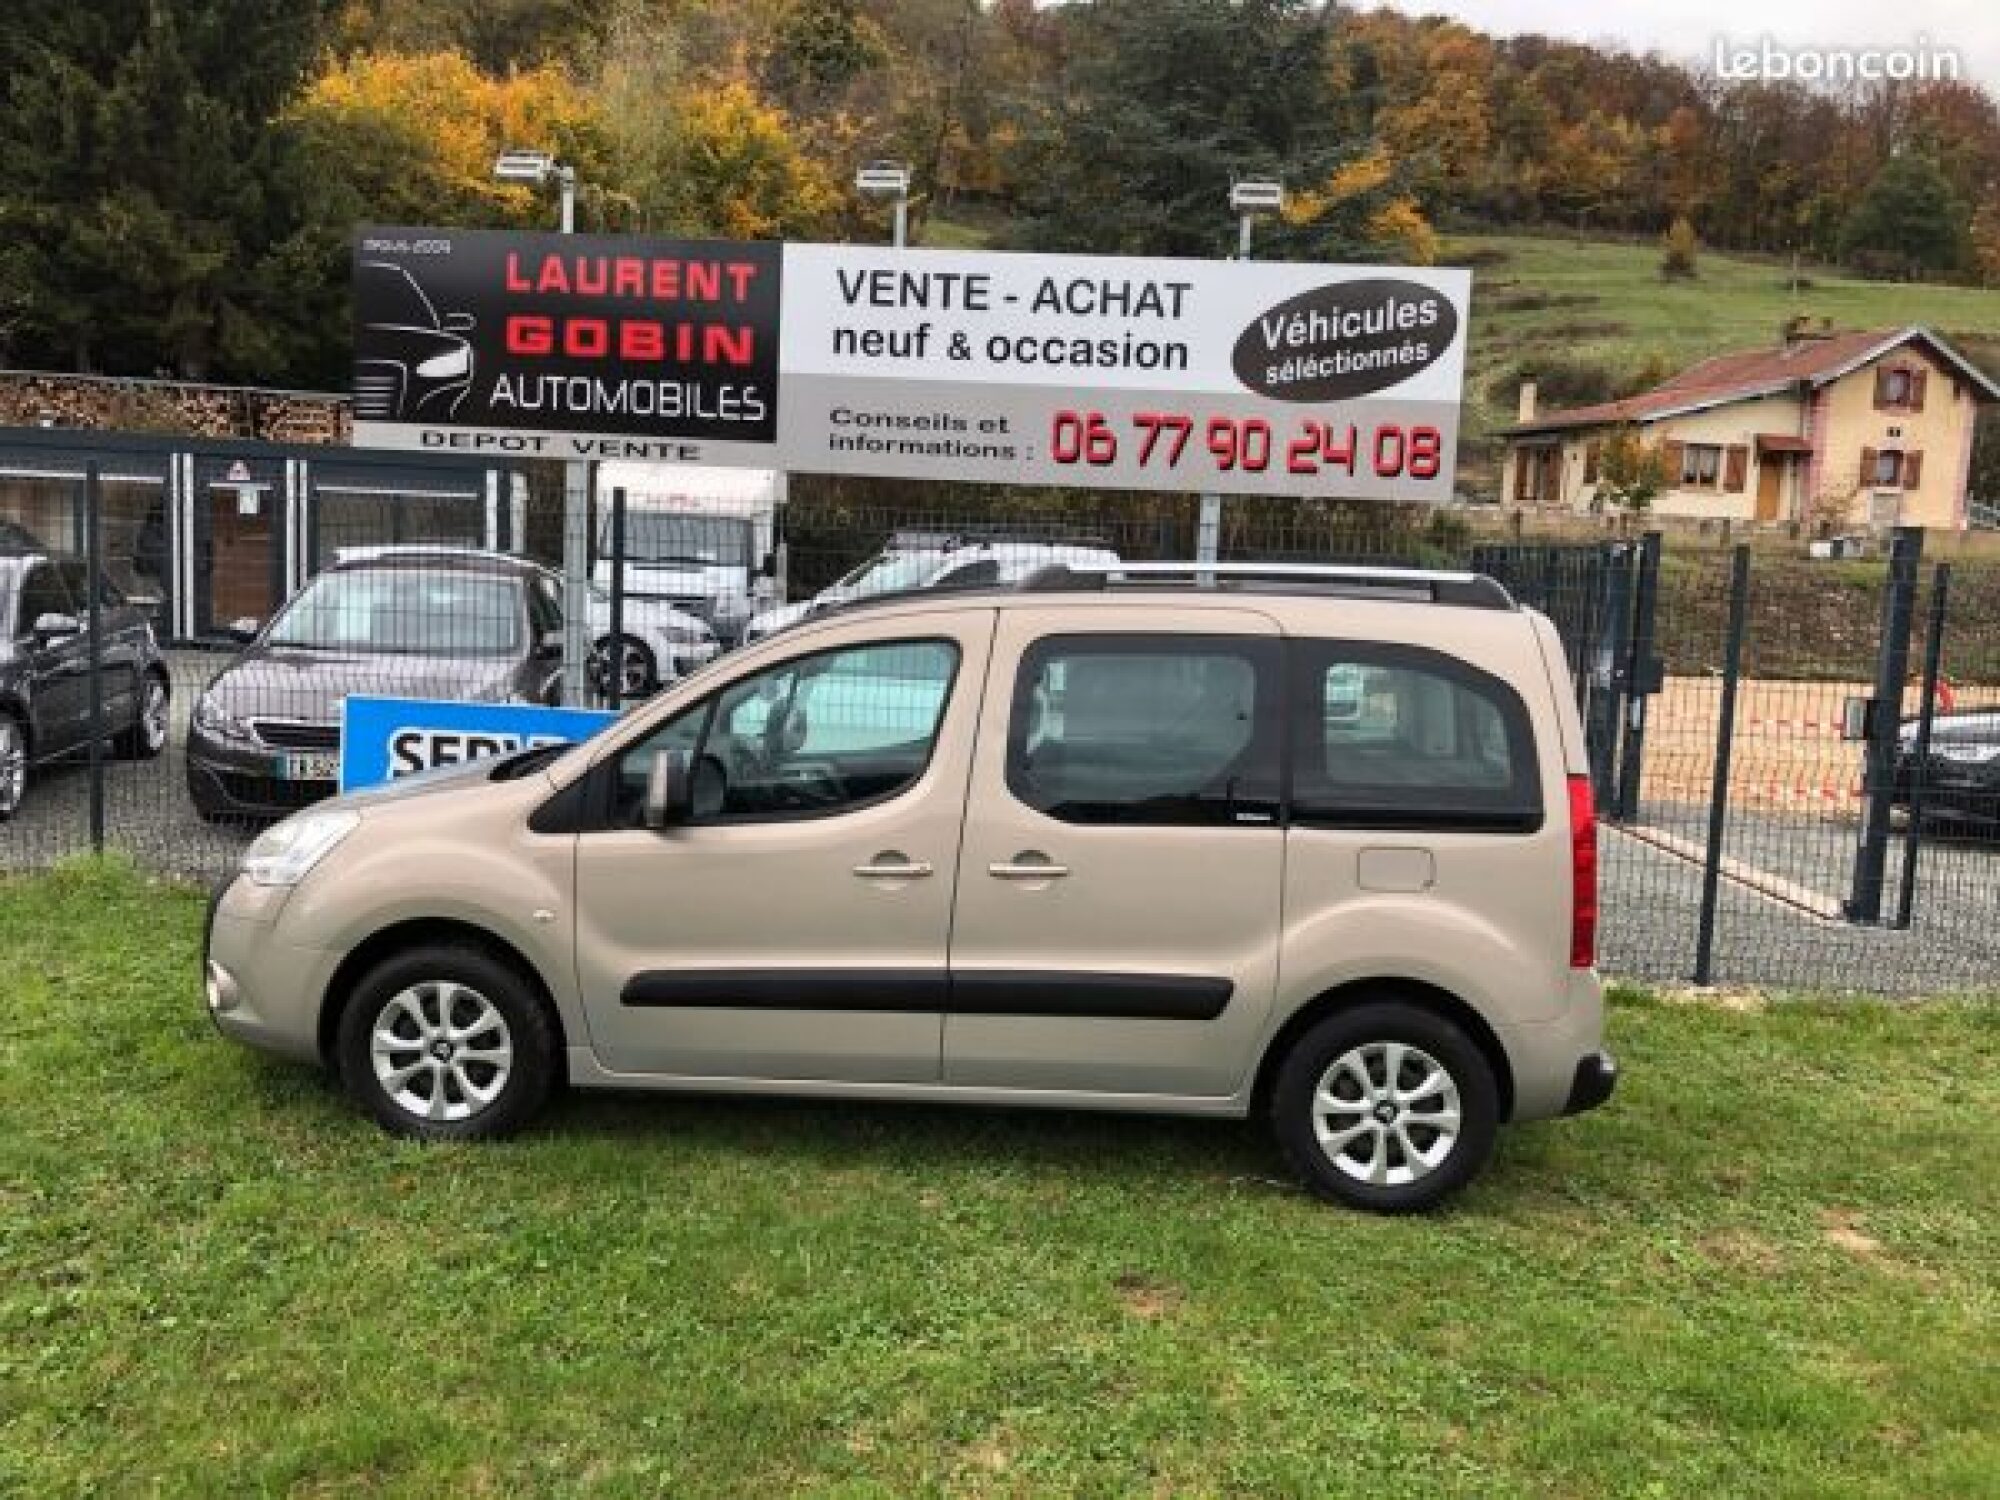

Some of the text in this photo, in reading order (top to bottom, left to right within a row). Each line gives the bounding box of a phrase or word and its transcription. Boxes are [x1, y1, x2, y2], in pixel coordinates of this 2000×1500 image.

[505, 251, 757, 302] LAURENT
[837, 268, 990, 310] VENTE
[1030, 276, 1192, 318] ACHAT
[505, 315, 755, 365] GOBIN
[833, 322, 1189, 371] neuf & occasion
[1259, 297, 1440, 352] Véhicules
[1265, 339, 1431, 385] séléctionnés
[489, 372, 765, 422] AUTOMOBILES
[829, 408, 1011, 434] Conseils et
[420, 430, 700, 461] DEPOT VENTE
[829, 432, 1017, 461] informations
[1051, 409, 1442, 480] 06 77 90 24 08
